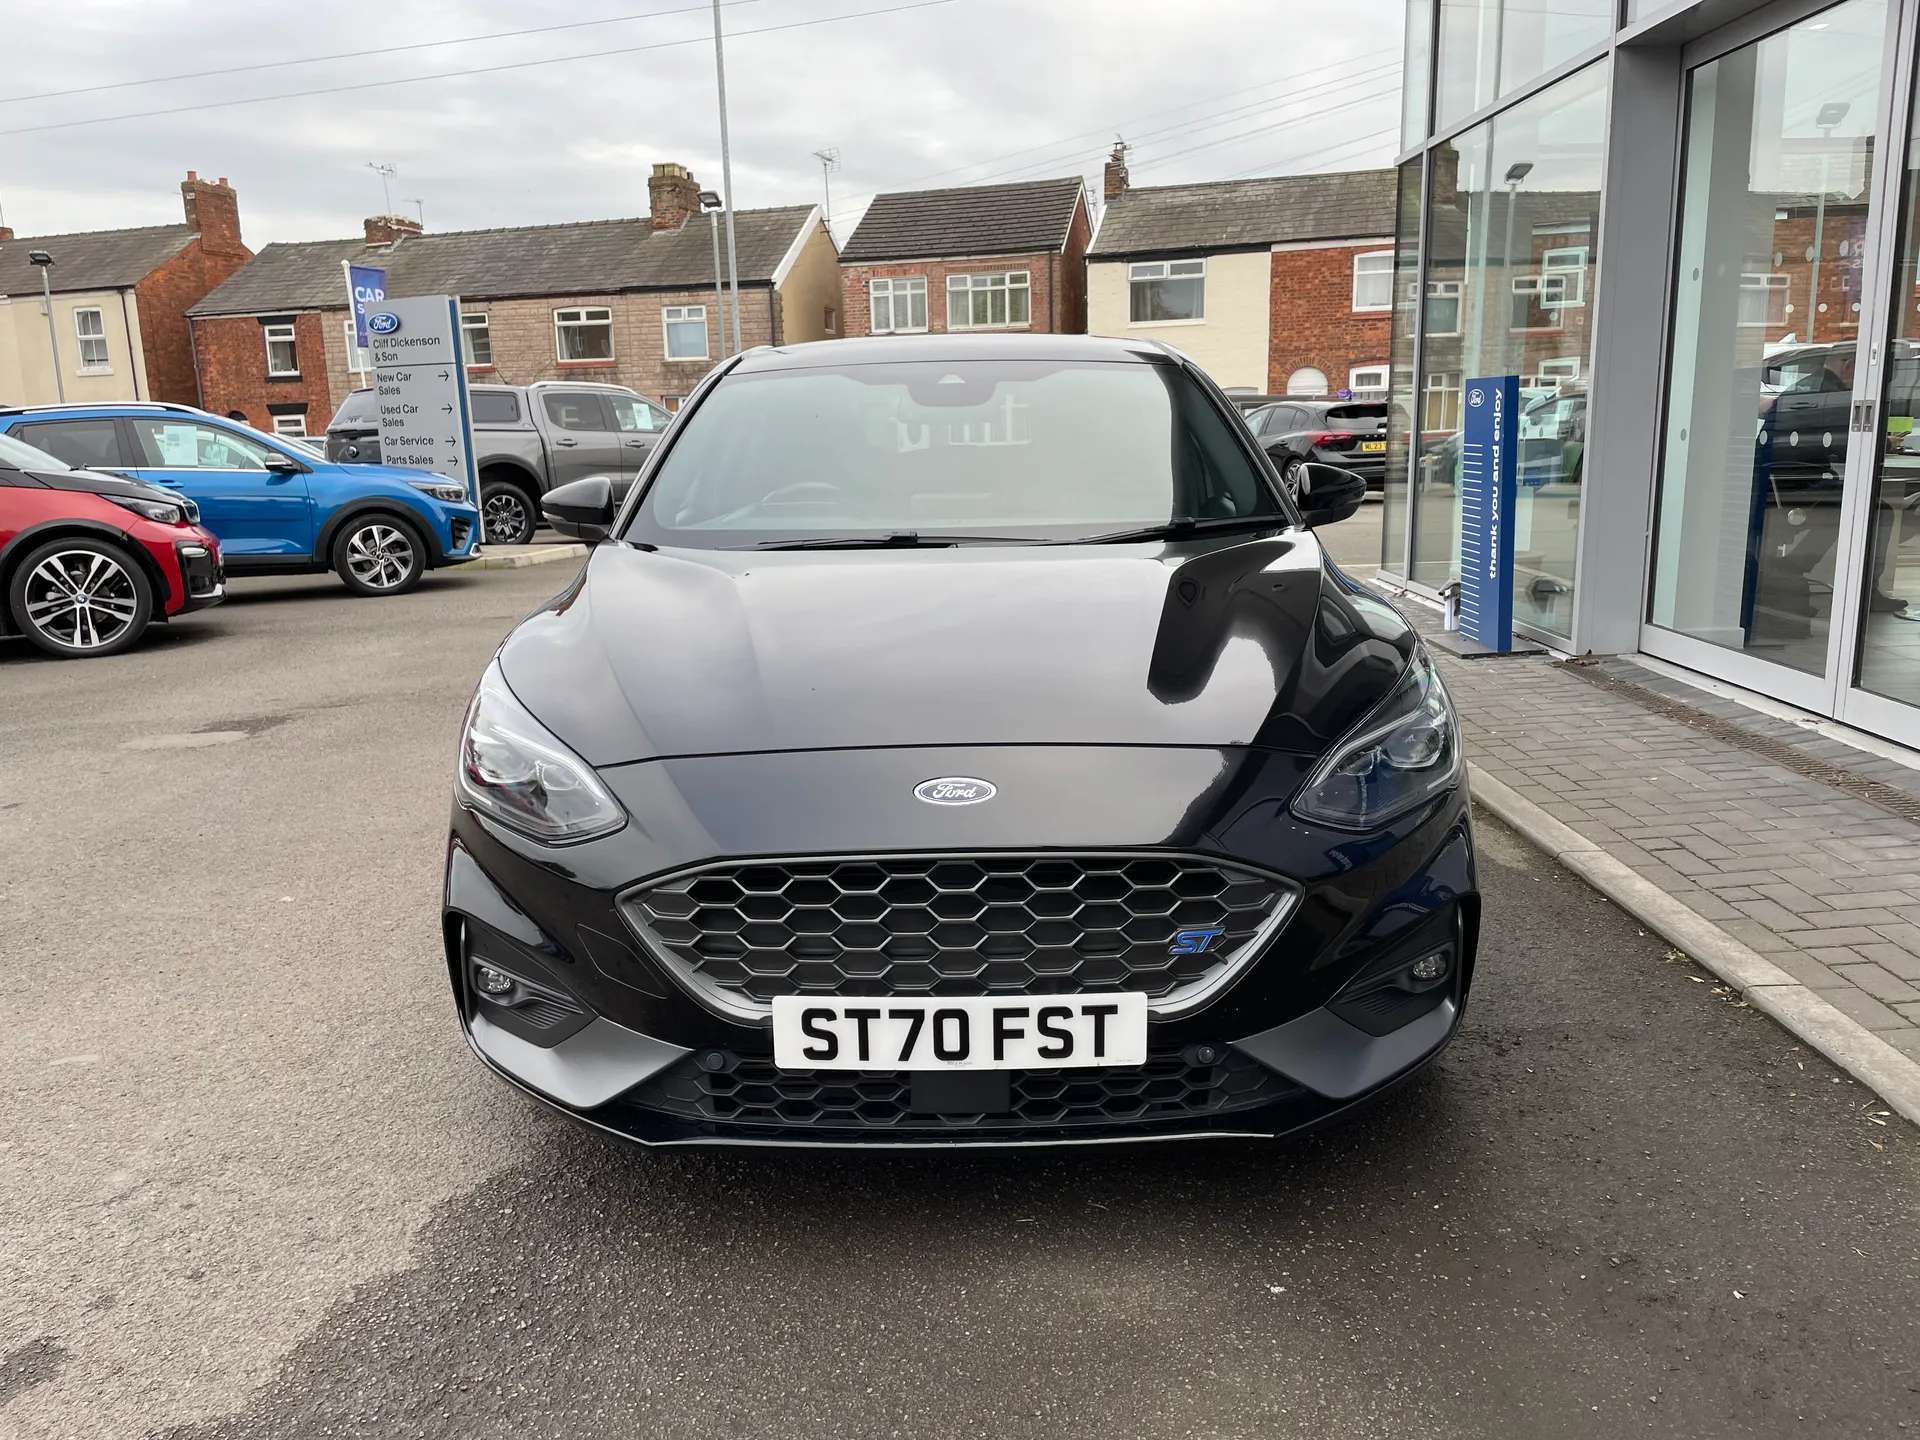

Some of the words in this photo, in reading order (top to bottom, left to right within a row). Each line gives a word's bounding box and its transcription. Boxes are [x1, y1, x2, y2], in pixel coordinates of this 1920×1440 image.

[355, 286, 385, 302] CAR
[373, 338, 389, 349] Cliff
[390, 337, 441, 348] Dickenson
[375, 352, 381, 362] &
[381, 351, 398, 361] Son
[377, 372, 395, 382] New
[396, 371, 411, 382] Car
[378, 385, 401, 395] Sales
[380, 404, 401, 415] Used
[402, 403, 419, 414] Car
[1493, 387, 1503, 442] enjoy
[382, 417, 405, 427] Sales
[384, 435, 398, 446] Car
[399, 435, 434, 446] Service
[386, 455, 407, 465] Parts
[408, 455, 434, 465] Sales
[1492, 445, 1500, 483] and
[1489, 523, 1498, 580] thank
[932, 783, 977, 798] Ford
[1168, 926, 1225, 954] ST
[801, 1007, 970, 1062] ST70
[993, 1004, 1118, 1060] FST
